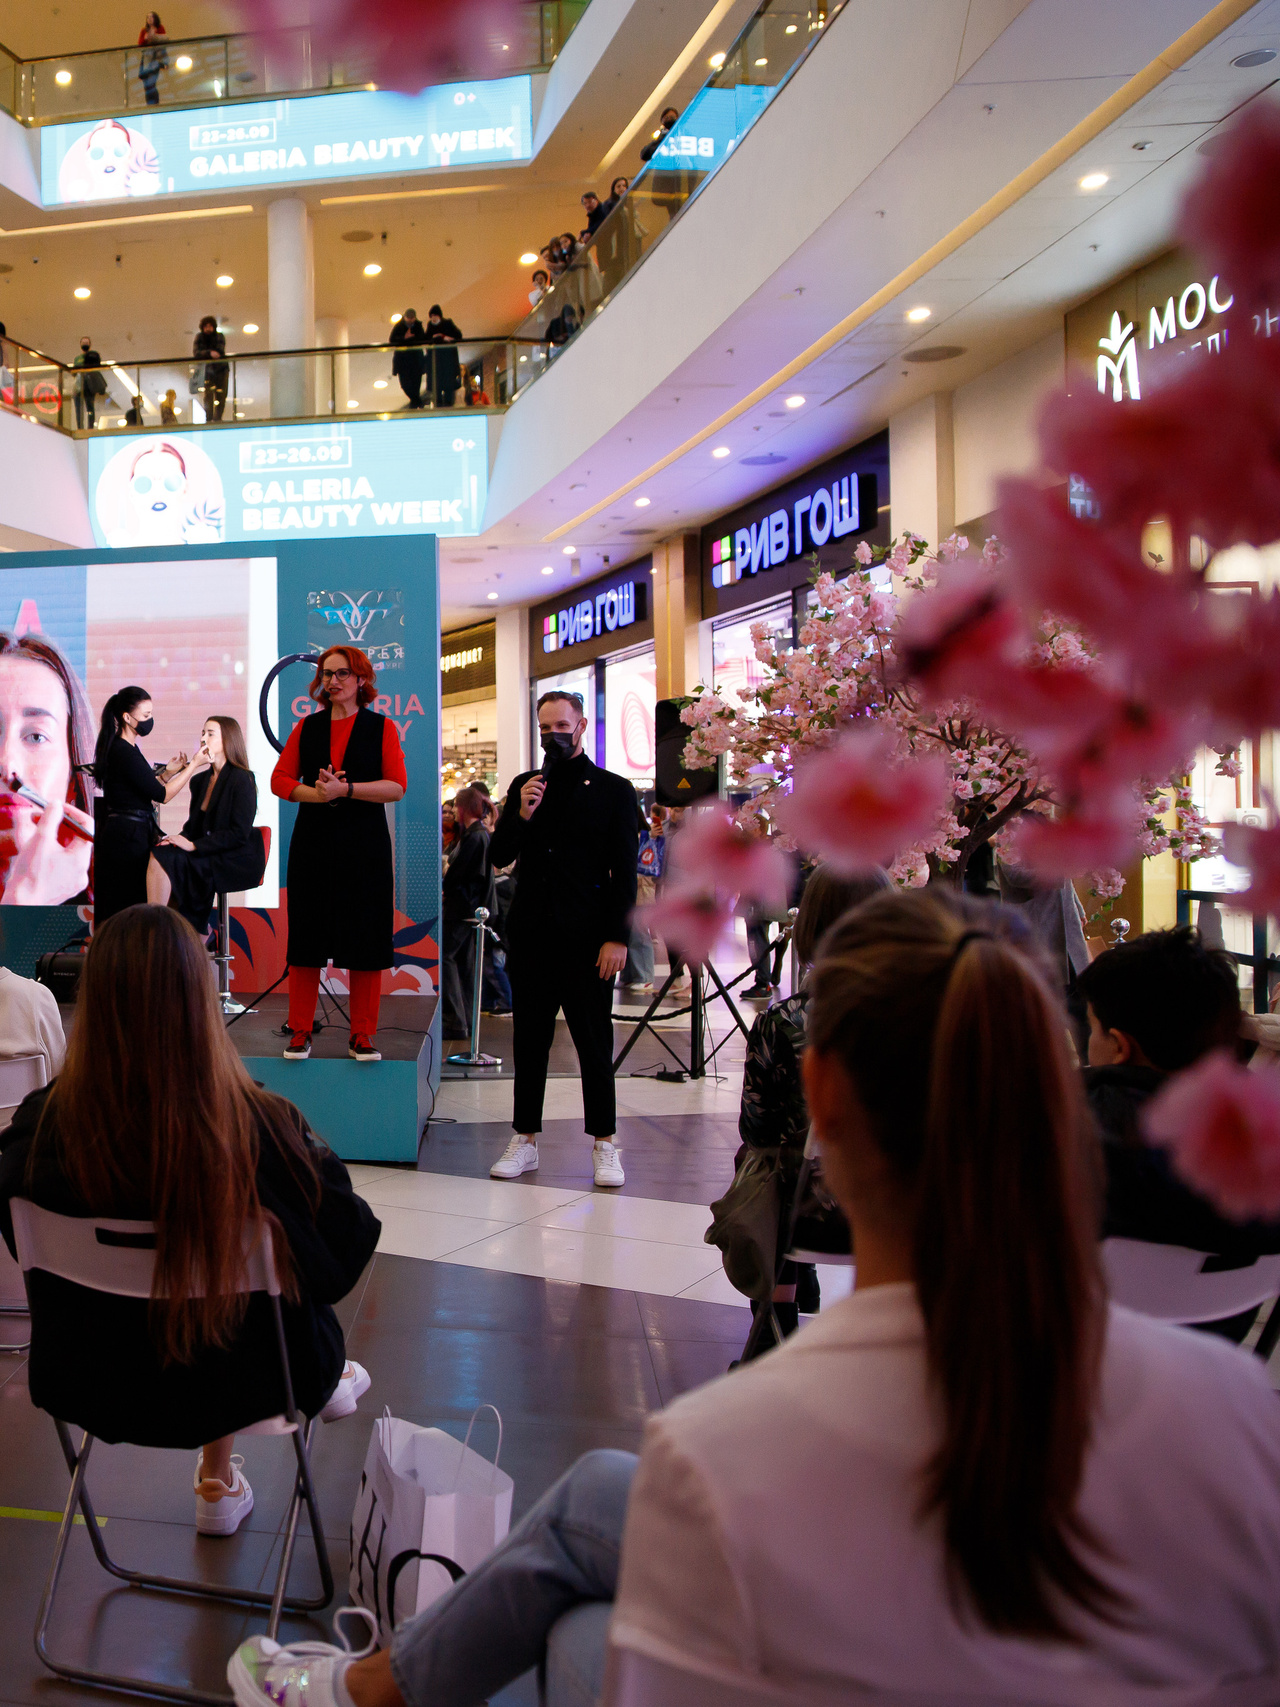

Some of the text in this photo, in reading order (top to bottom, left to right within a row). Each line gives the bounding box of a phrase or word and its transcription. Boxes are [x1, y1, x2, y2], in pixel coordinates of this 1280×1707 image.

[200, 124, 271, 144] 23-26.09
[189, 126, 516, 178] GALERIA BEAUTY WEEK
[254, 445, 343, 466] 23-26.09
[452, 438, 476, 452] 0+
[242, 476, 375, 504] GALERIA
[243, 499, 463, 531] BEAUTY WEEK
[735, 472, 860, 581] РИВ ГОШ
[558, 580, 635, 649] РИВ ГОШ
